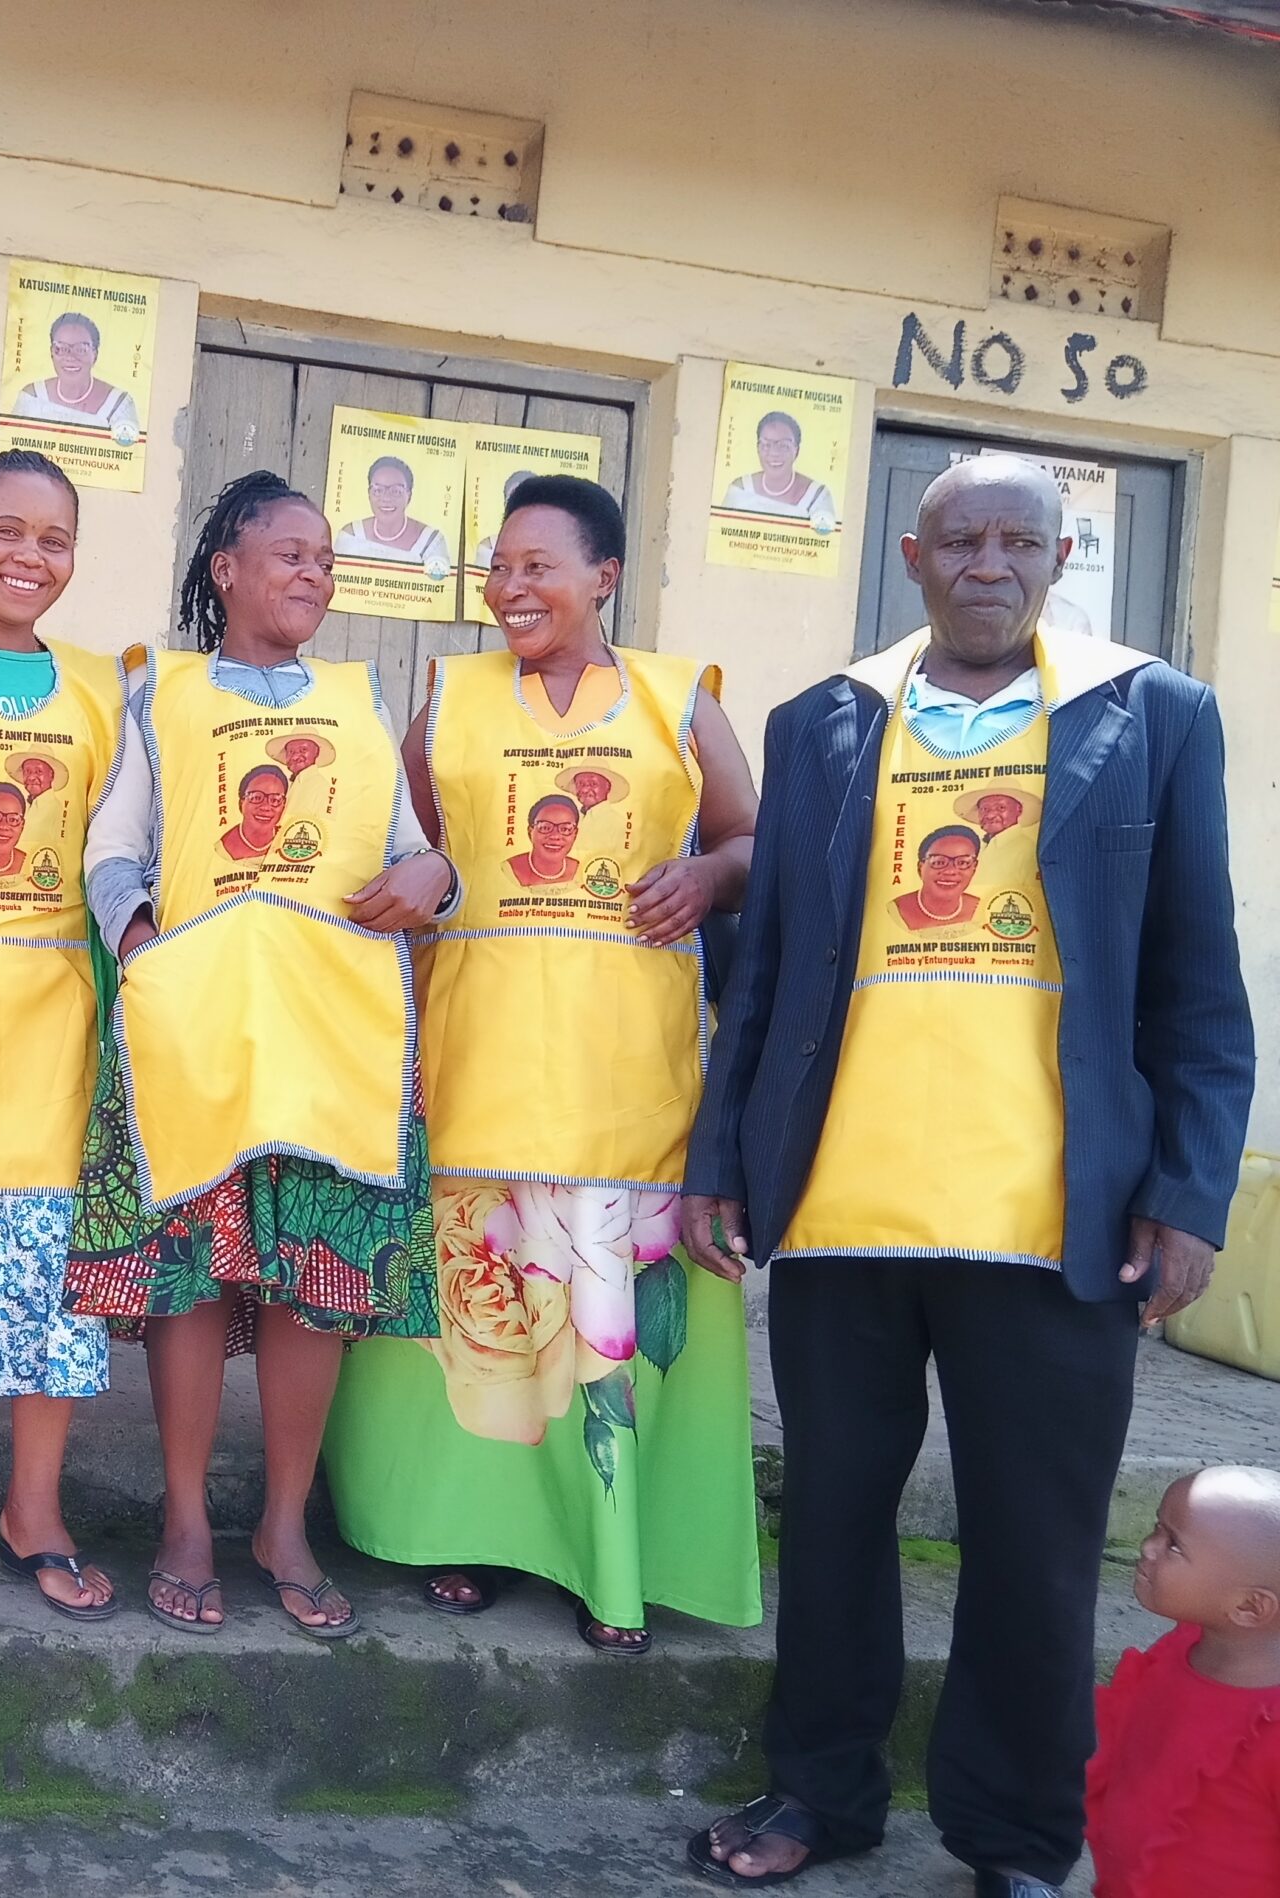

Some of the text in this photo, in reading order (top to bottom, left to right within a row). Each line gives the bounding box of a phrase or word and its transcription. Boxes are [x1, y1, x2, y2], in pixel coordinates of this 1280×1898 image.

[19, 278, 147, 306] KATUSIIME ANNET MUGISHA
[892, 312, 1026, 395] NO
[730, 379, 843, 404] KATUSIIME ANNET MUGISHA
[341, 423, 457, 449] KATUSIIME ANNET MUGISHA
[12, 437, 133, 460] WOMAN MP BUSHENYI DISTRICT
[475, 440, 589, 462] KATUSIIME ANNET MUGISHA
[1053, 466, 1105, 483] VIANAH
[721, 527, 830, 548] WOMAN MP BUSHENYI DISTRICT
[332, 574, 444, 593] WOMAN MP BUSHENYI DISTRICT
[339, 587, 369, 596] EMBIBO
[5, 730, 32, 742] ANNET
[34, 733, 73, 745] MUGISHA
[212, 717, 339, 738] KATUSIIME ANNET MUGISHA
[504, 747, 632, 759] KATUSIIME ANNET MUGISHA
[891, 770, 951, 784] KATUSIIME
[954, 767, 990, 780] ANNET
[218, 752, 227, 826] TEERERA
[327, 777, 337, 814] VOTE
[942, 784, 964, 792] 2031
[506, 773, 517, 846] TEERERA
[892, 803, 906, 885] TEERERA
[214, 872, 245, 887] WOMAN
[276, 864, 315, 874] DISTRICT
[33, 892, 63, 903] DISTRICT
[499, 898, 623, 911] WOMAN MP BUSHENYI DISTRICT
[499, 909, 523, 918] Embibo
[887, 943, 1037, 955] WOMAN MP BUSHENYI DISTRICT
[887, 956, 915, 966] Embibo
